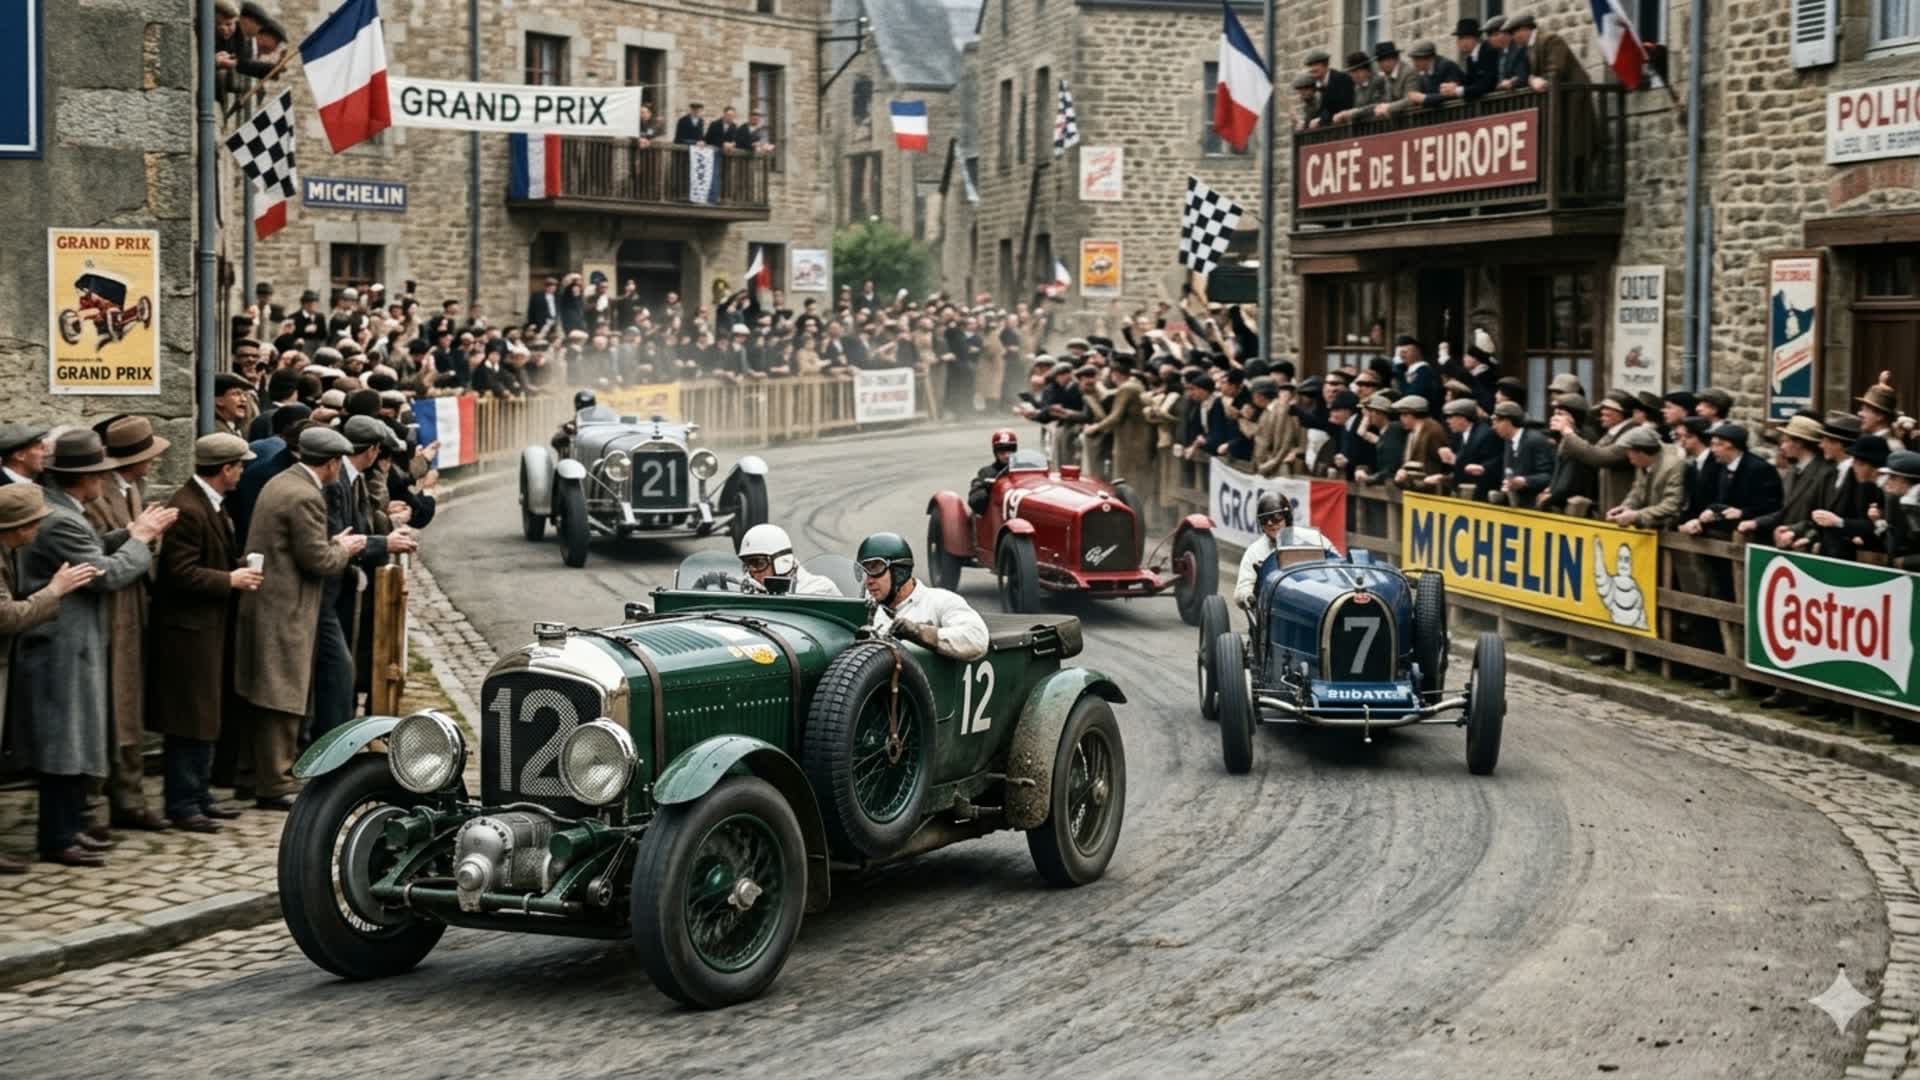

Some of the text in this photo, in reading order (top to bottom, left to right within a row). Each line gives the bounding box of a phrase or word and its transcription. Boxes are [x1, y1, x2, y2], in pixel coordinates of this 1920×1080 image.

[401, 86, 608, 125] GRAND PRIX
[1402, 121, 1528, 186] L'EUROPE
[308, 181, 404, 205] MICHELIN
[56, 236, 152, 250] GRAND PRIX
[56, 366, 153, 381] GRAND PRIX
[641, 459, 678, 497] 21
[1411, 508, 1584, 602] MICHELIN
[1765, 566, 1892, 662] Castrol
[1343, 616, 1381, 675] 7
[960, 660, 995, 736] 12
[488, 687, 580, 798] 12
